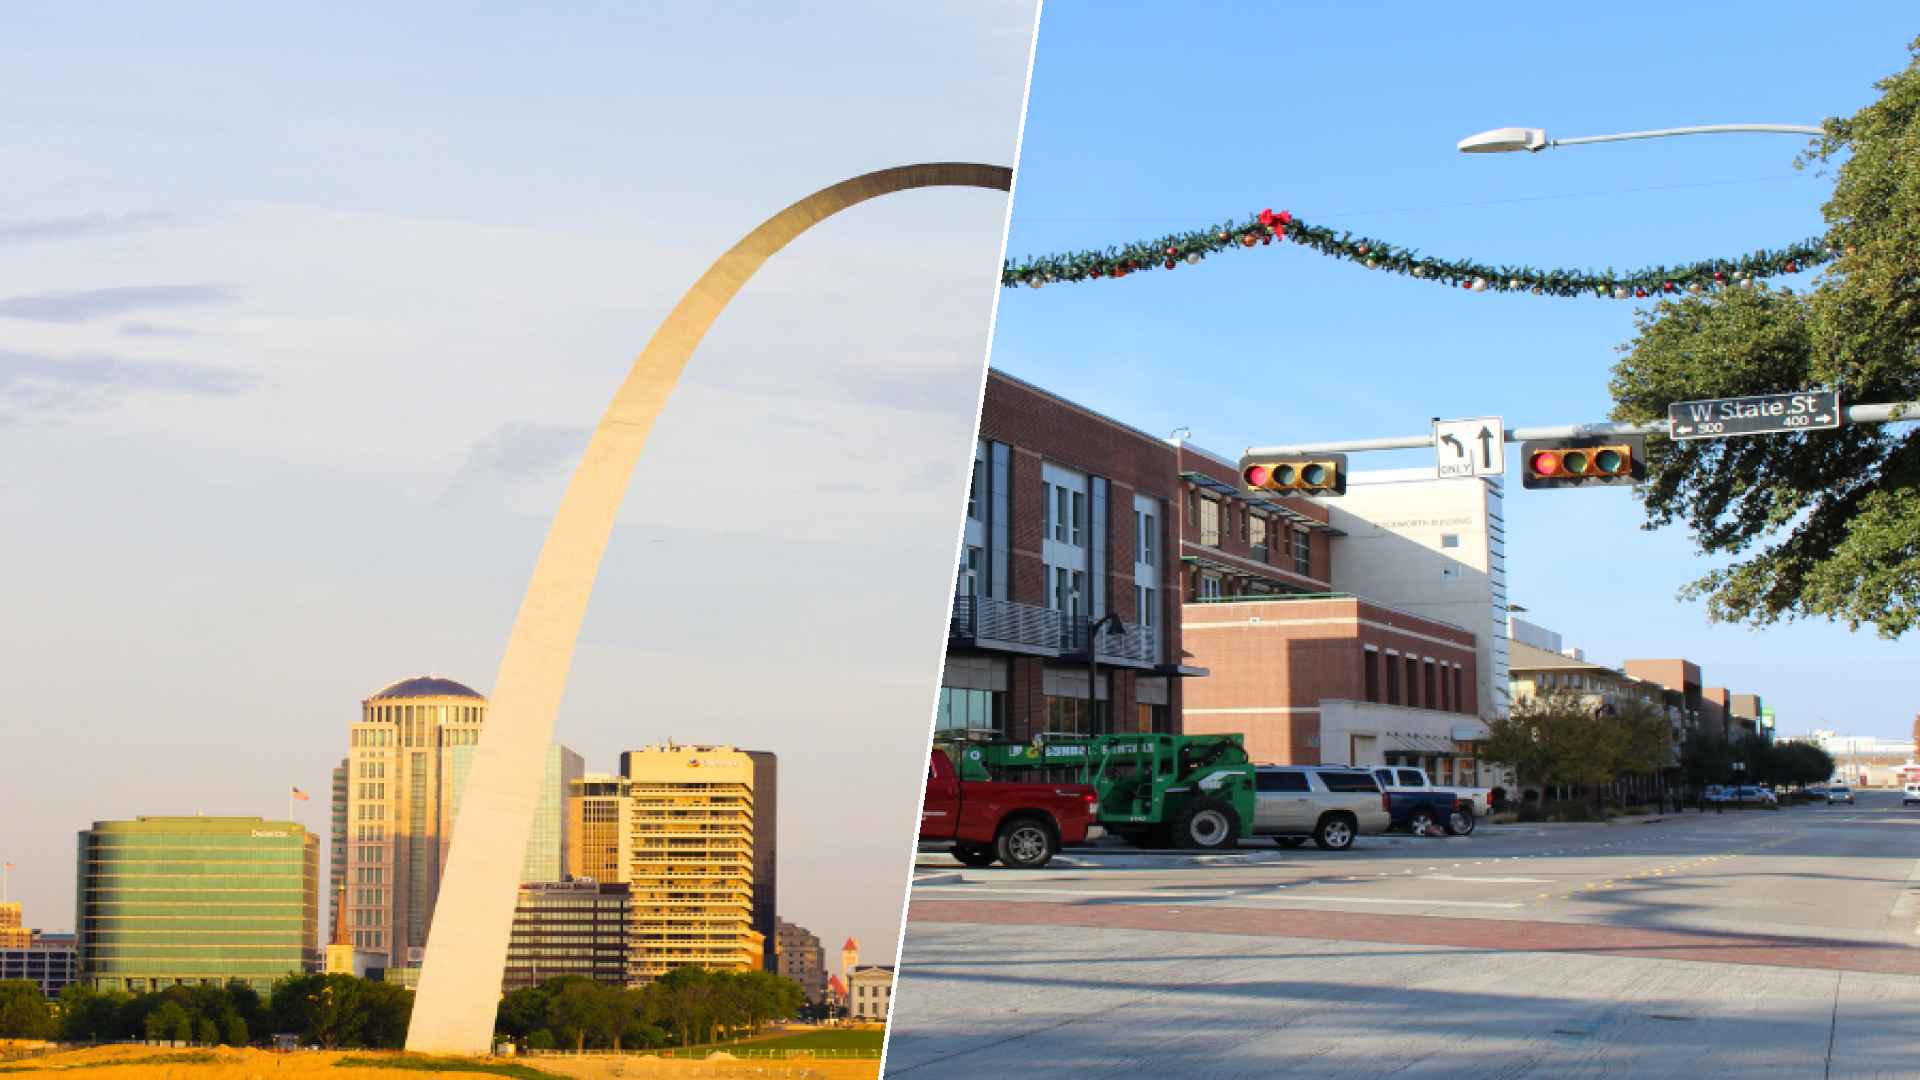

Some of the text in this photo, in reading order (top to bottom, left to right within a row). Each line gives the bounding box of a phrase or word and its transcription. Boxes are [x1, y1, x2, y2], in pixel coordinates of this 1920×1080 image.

[1690, 396, 1817, 422] W State St
[1783, 415, 1809, 427] 400
[1440, 464, 1471, 474] ONLY
